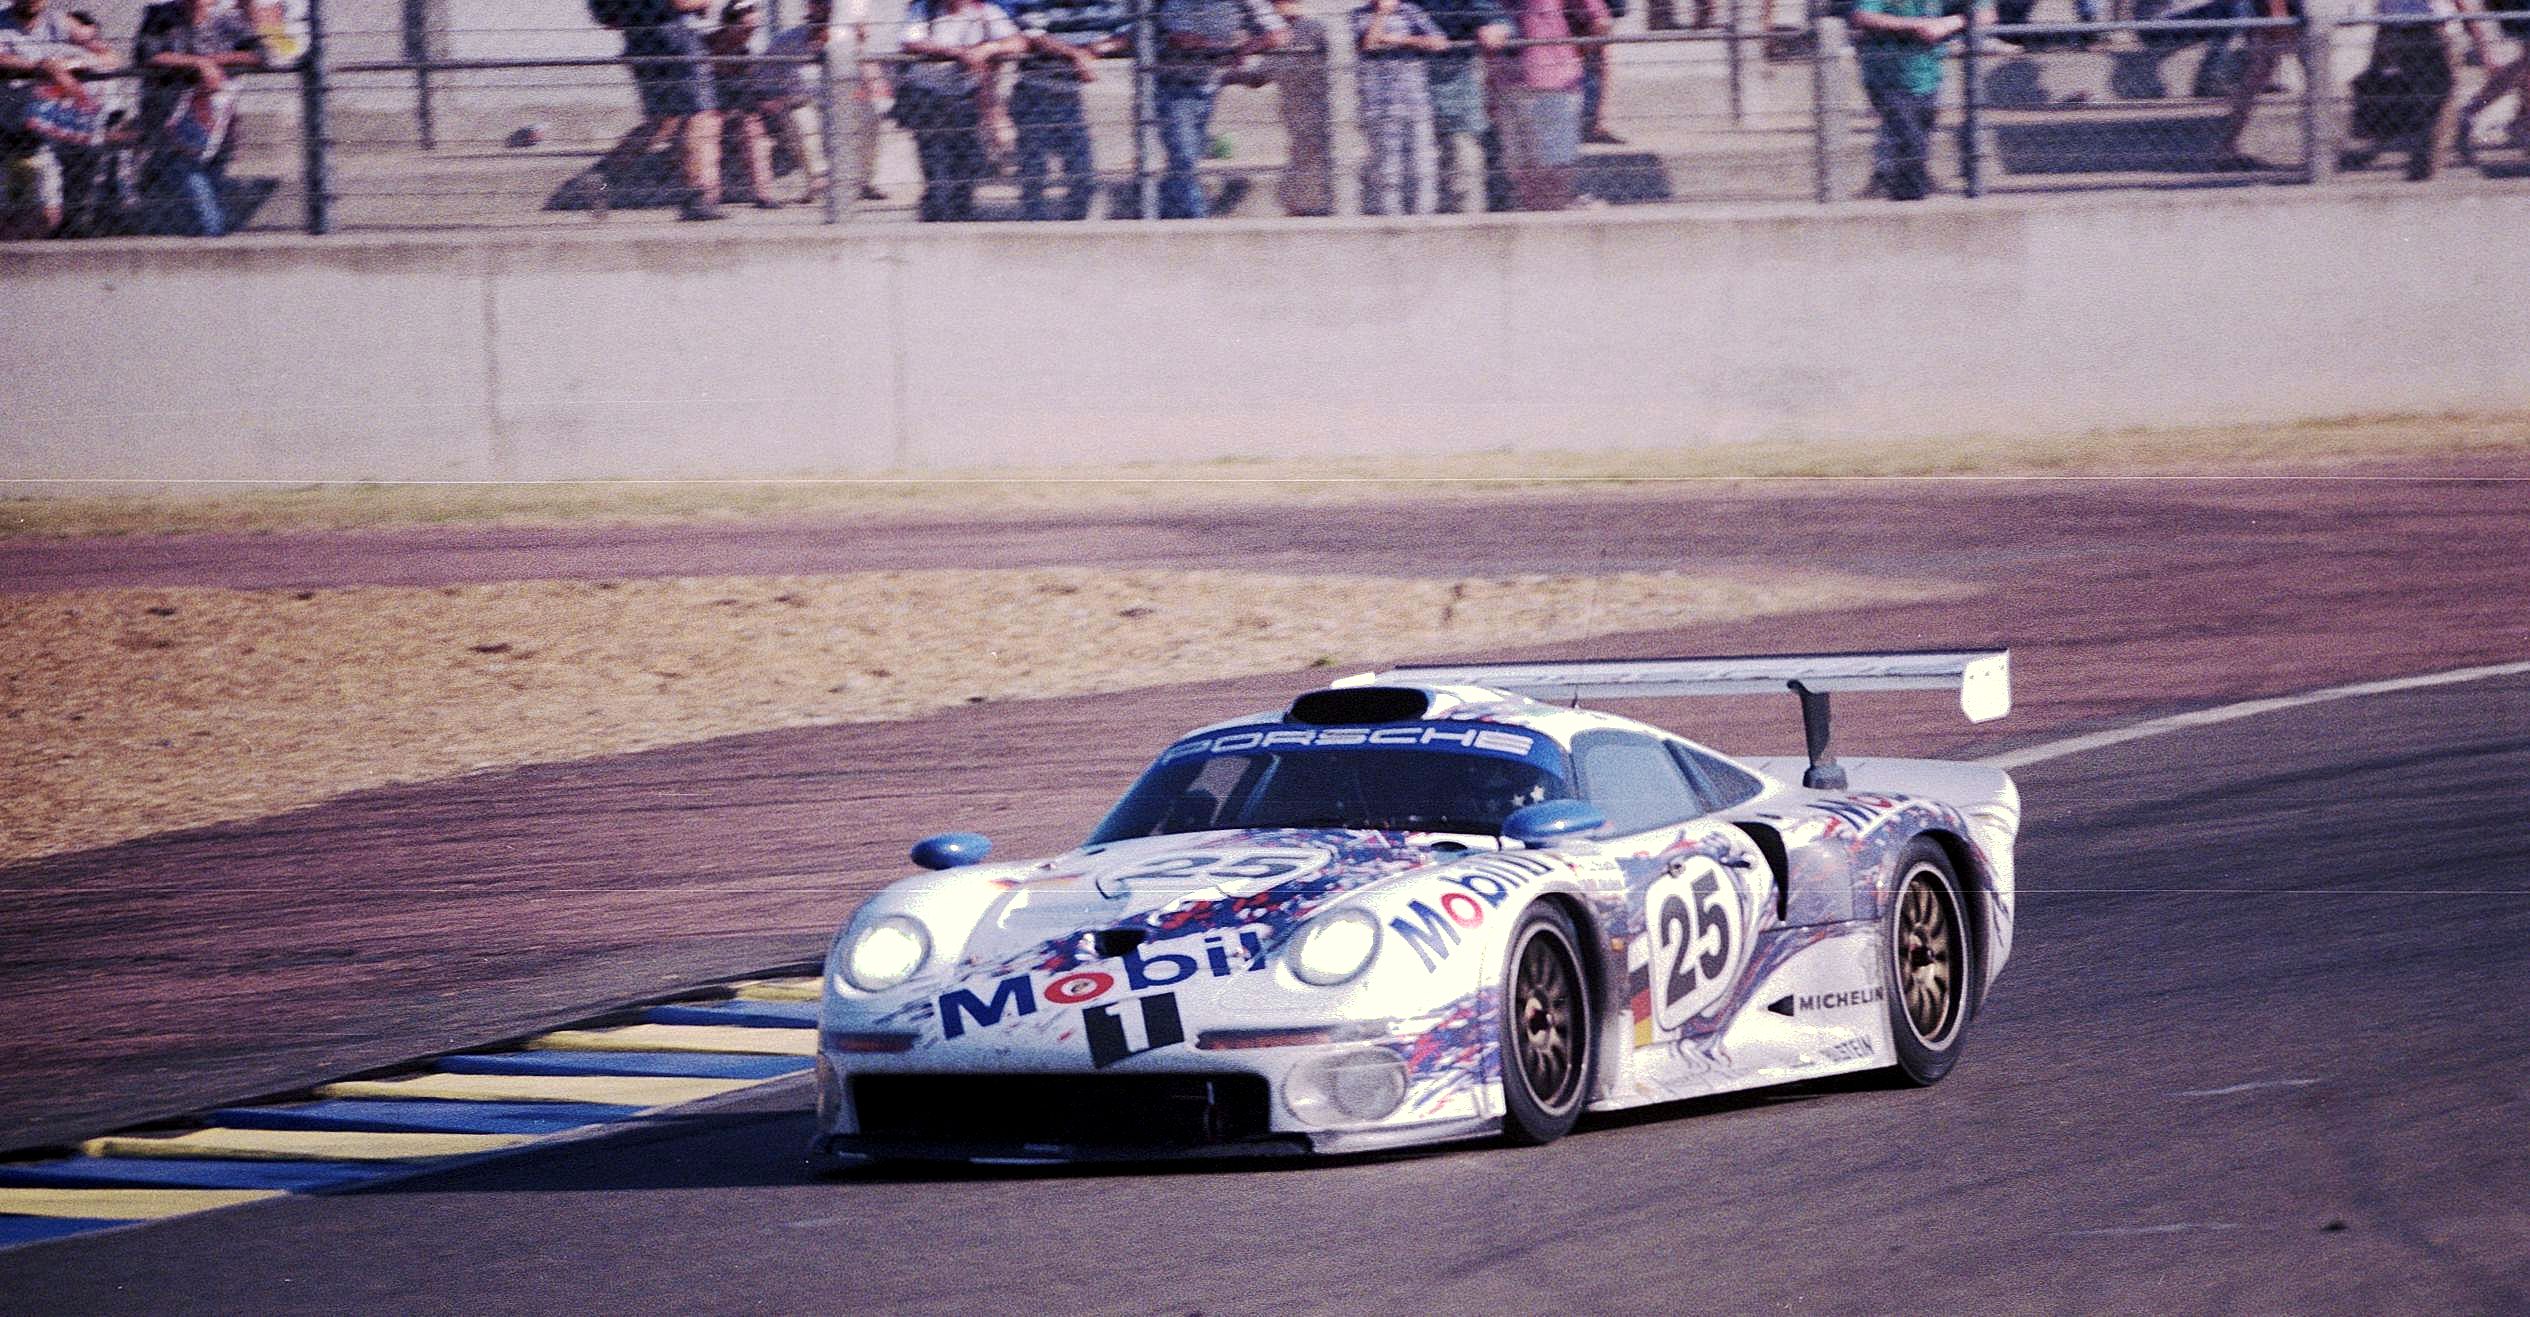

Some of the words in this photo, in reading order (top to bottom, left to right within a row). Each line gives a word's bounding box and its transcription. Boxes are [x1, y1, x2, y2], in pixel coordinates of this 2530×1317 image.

[1160, 727, 1534, 766] PORSCHE
[1661, 868, 1730, 1009] 25
[938, 930, 1267, 1041] Mobil
[1799, 986, 1884, 1011] MICHELIN
[1105, 996, 1151, 1053] 1
